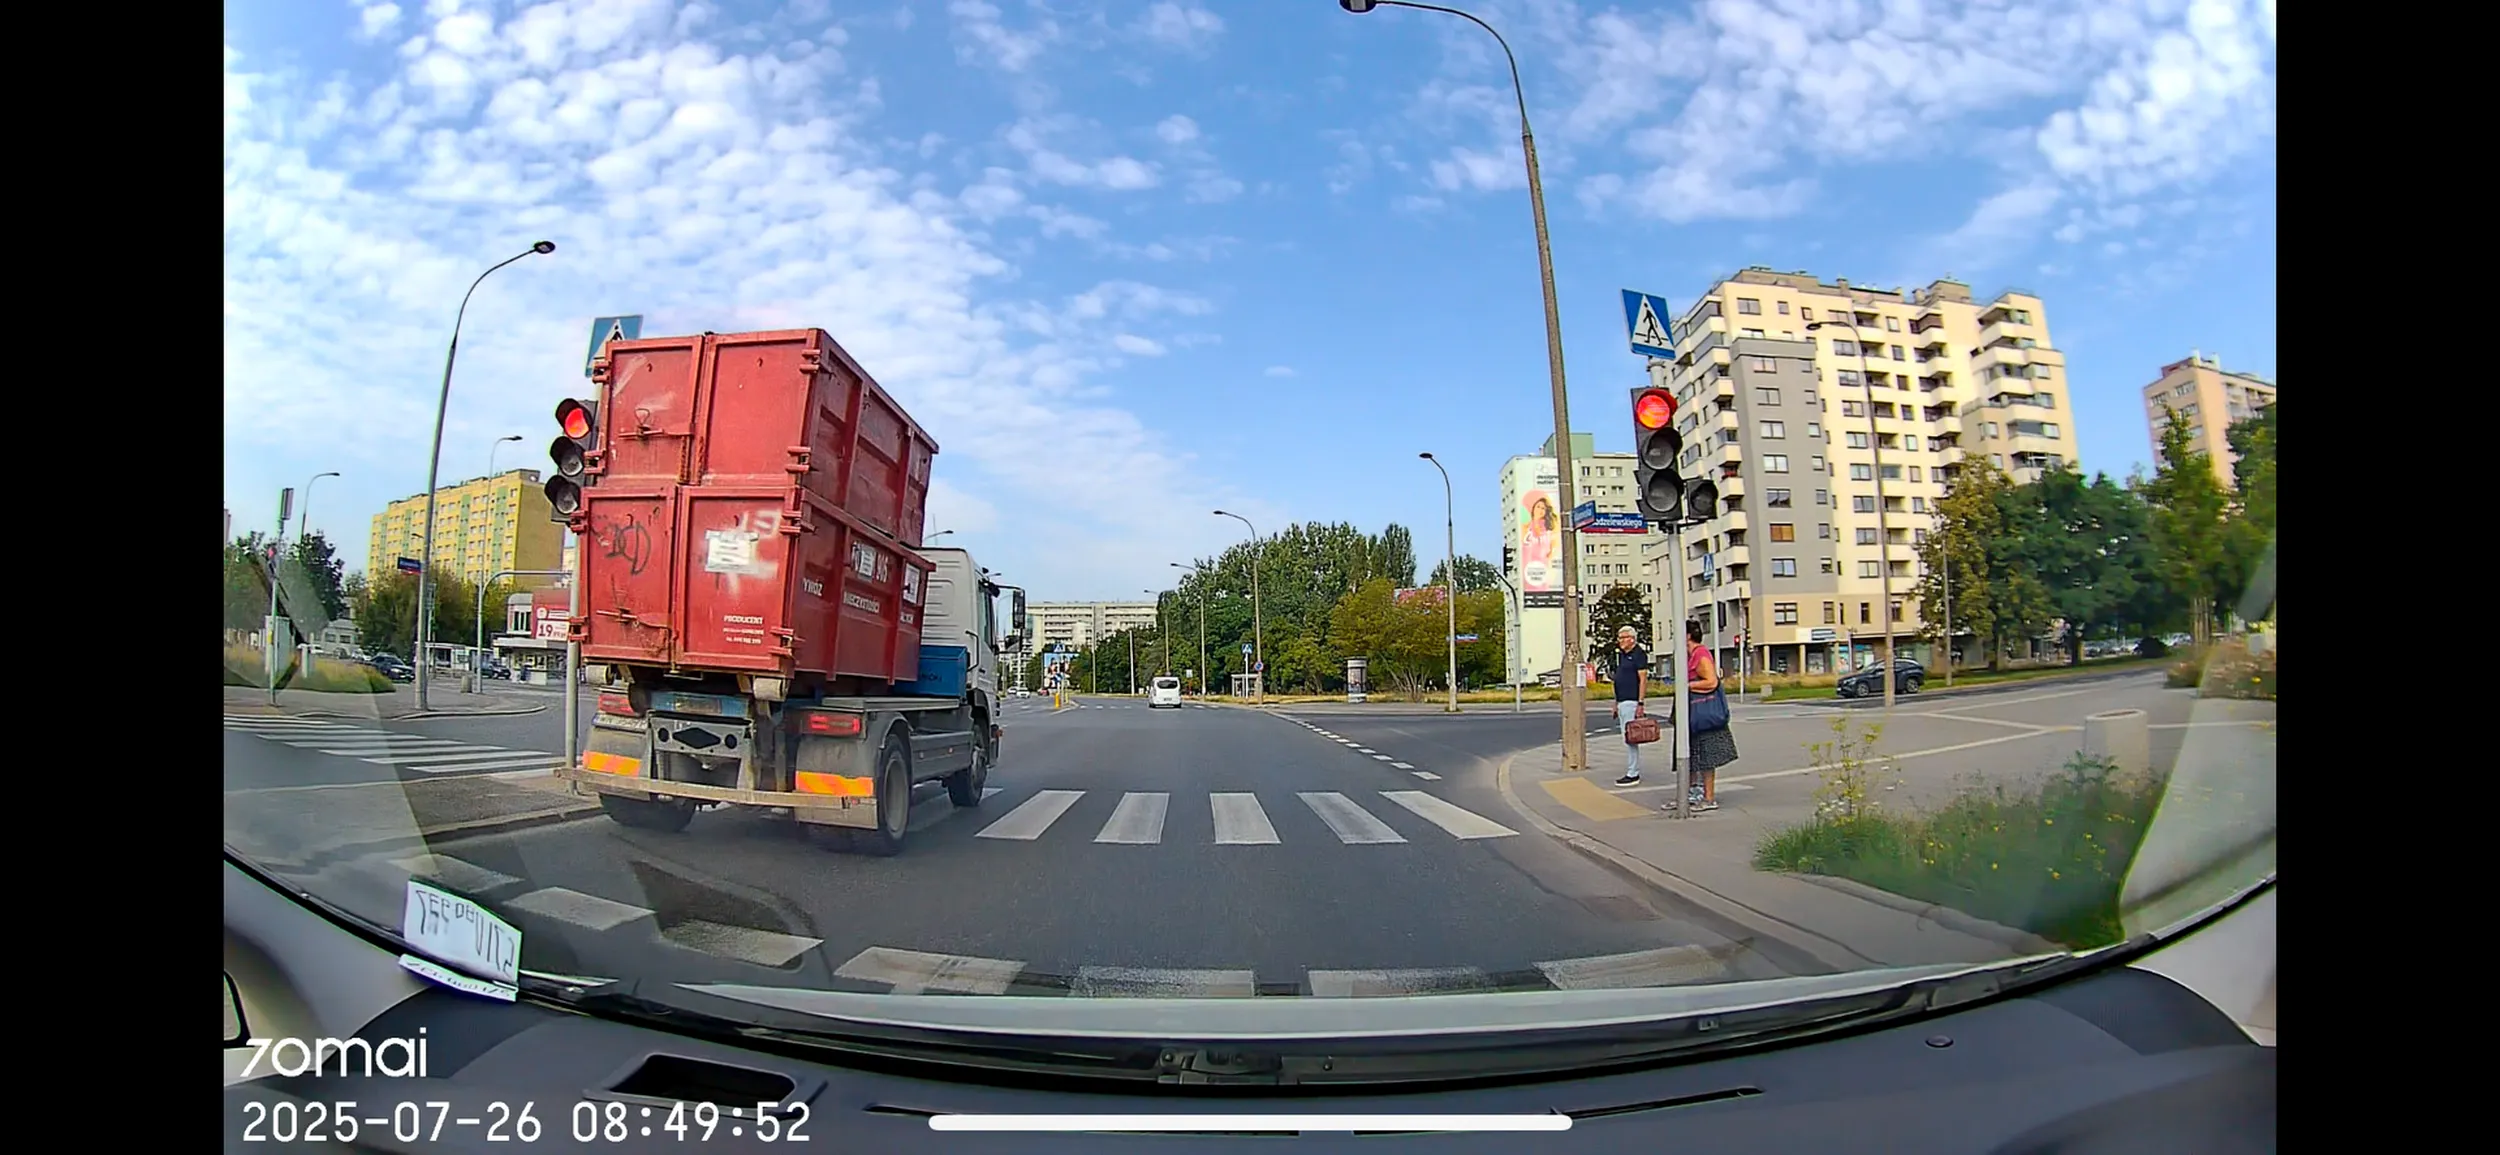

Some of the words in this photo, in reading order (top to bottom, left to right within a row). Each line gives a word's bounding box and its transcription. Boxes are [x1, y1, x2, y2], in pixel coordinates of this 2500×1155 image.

[1592, 516, 1643, 529] odzelewskiego
[723, 615, 763, 625] PRODUCENT
[538, 623, 553, 637] 19
